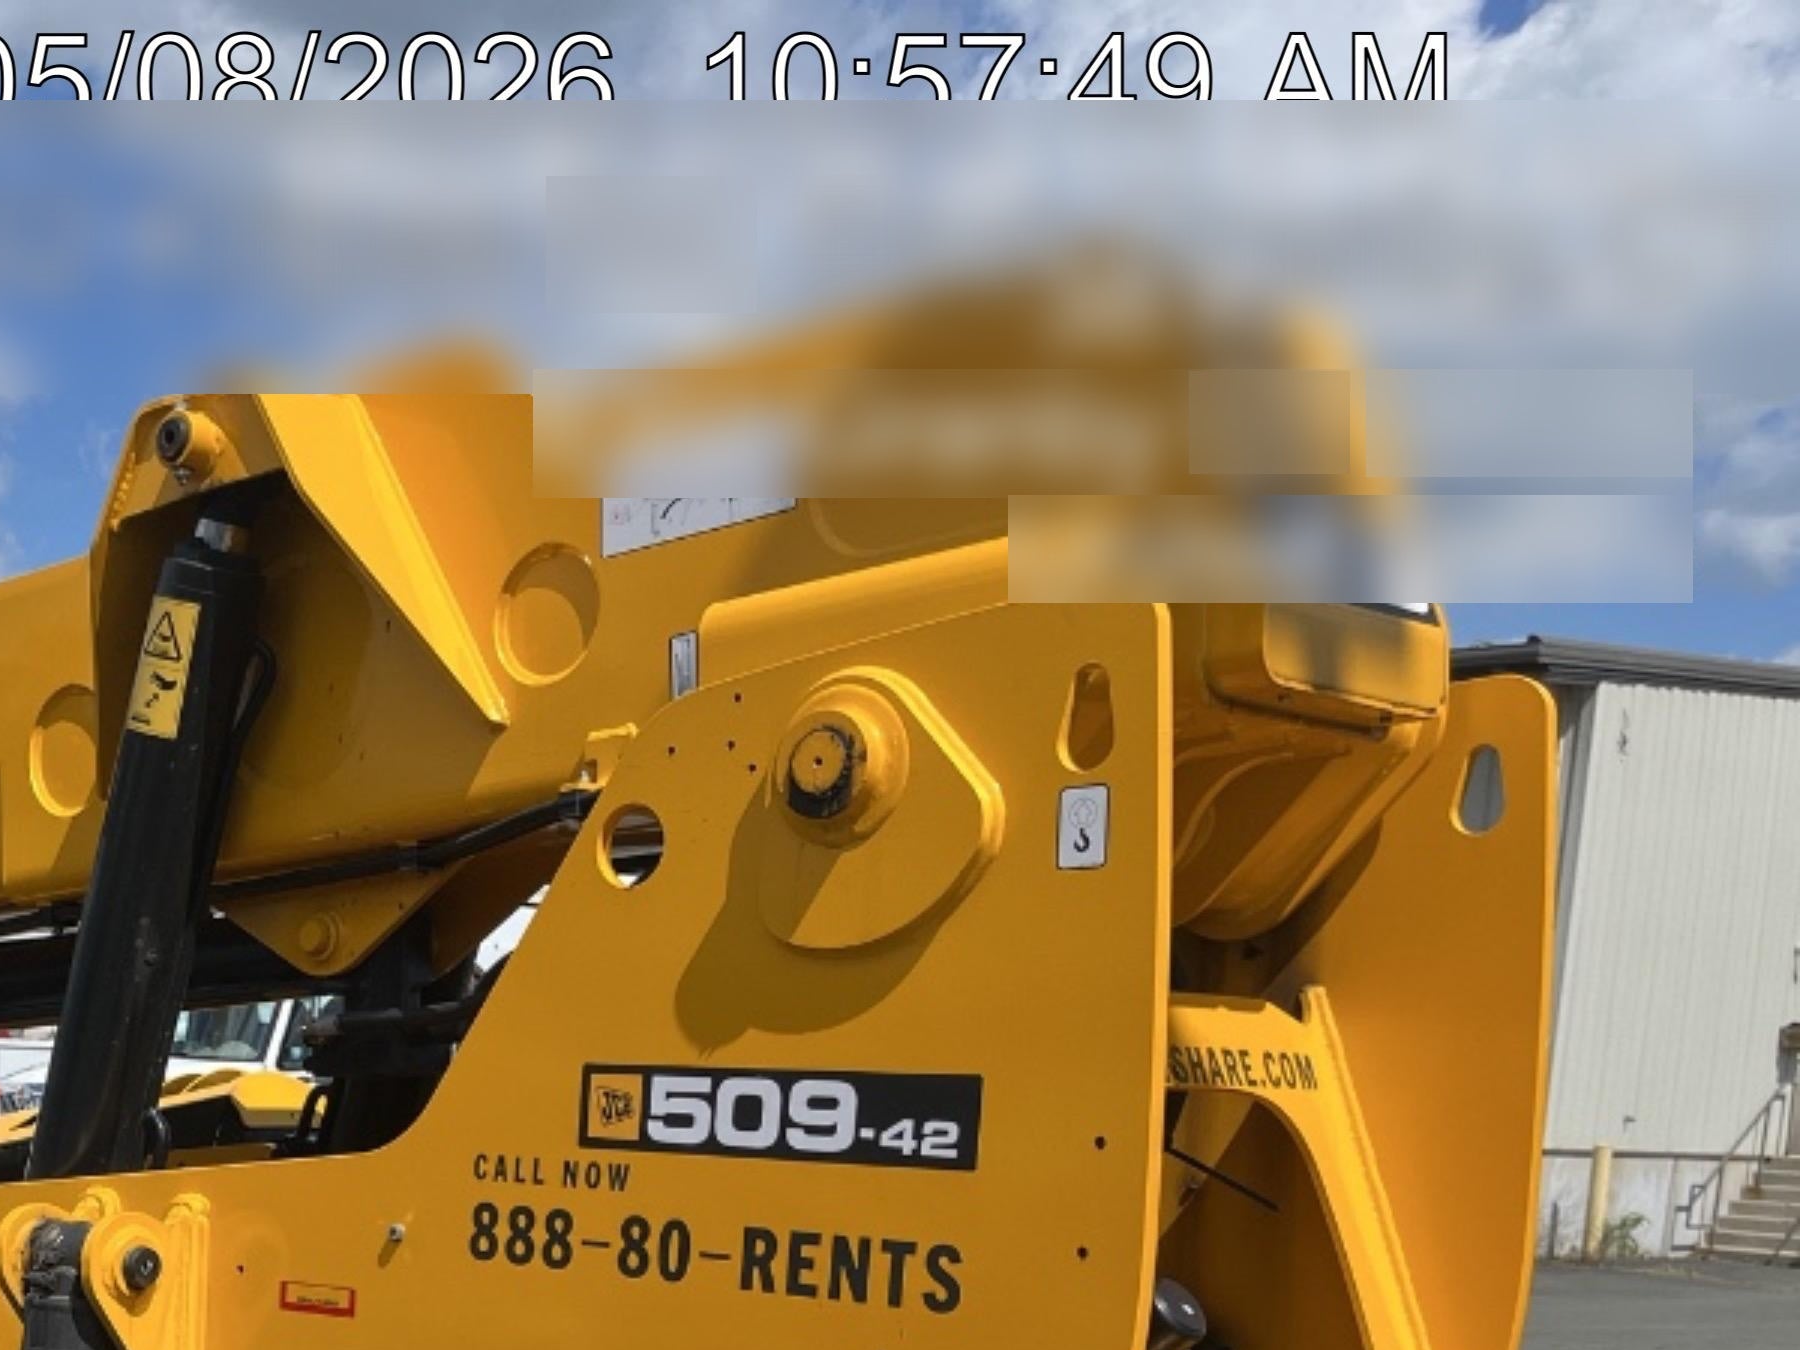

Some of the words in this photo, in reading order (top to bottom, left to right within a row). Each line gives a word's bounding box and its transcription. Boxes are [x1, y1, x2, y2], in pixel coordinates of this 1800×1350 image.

[1166, 1044, 1319, 1090] SHARE.COM
[647, 1074, 961, 1159] 509-42
[473, 1153, 545, 1186] CALL
[562, 1160, 631, 1192] NOW
[468, 1201, 964, 1314] 888-80-RENTS
